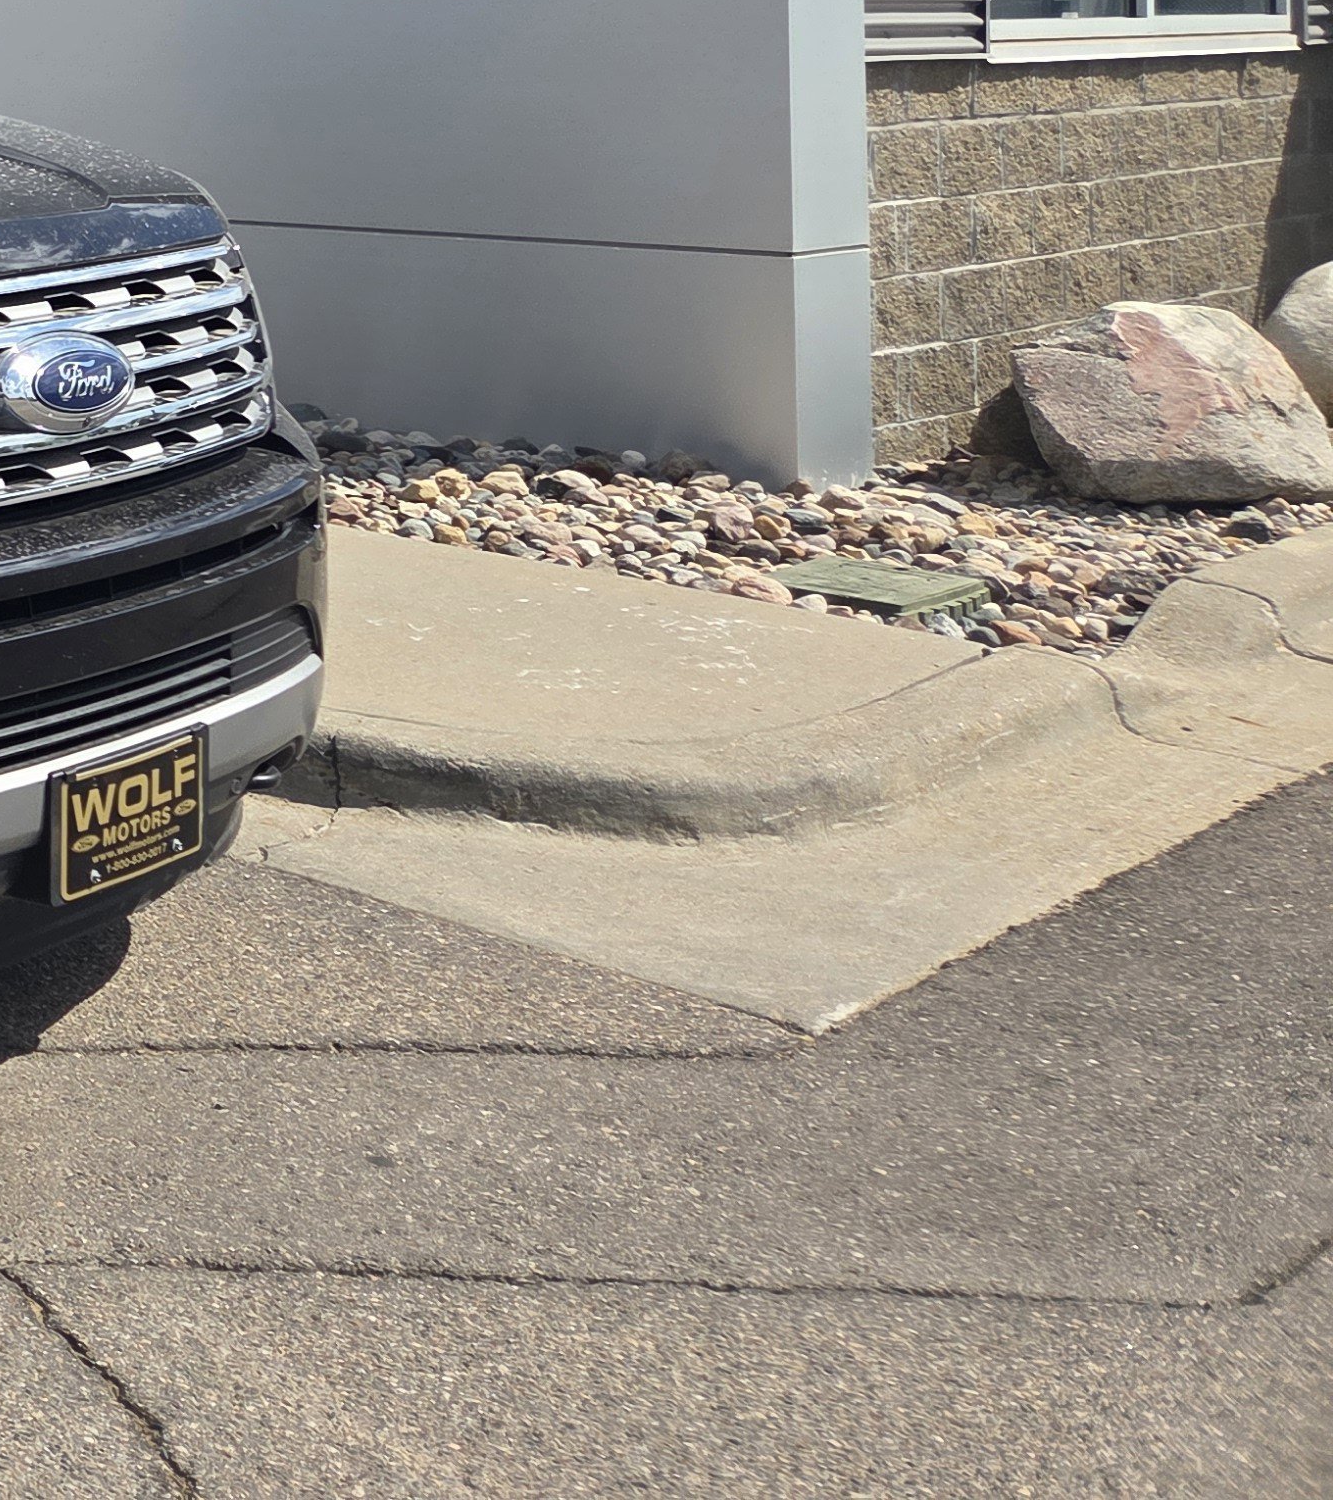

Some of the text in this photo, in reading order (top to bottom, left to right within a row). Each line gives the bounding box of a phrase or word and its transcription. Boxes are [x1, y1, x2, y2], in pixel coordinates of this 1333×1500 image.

[58, 359, 115, 401] Ford
[71, 753, 197, 833] WOLF
[102, 806, 171, 847] MOTORS
